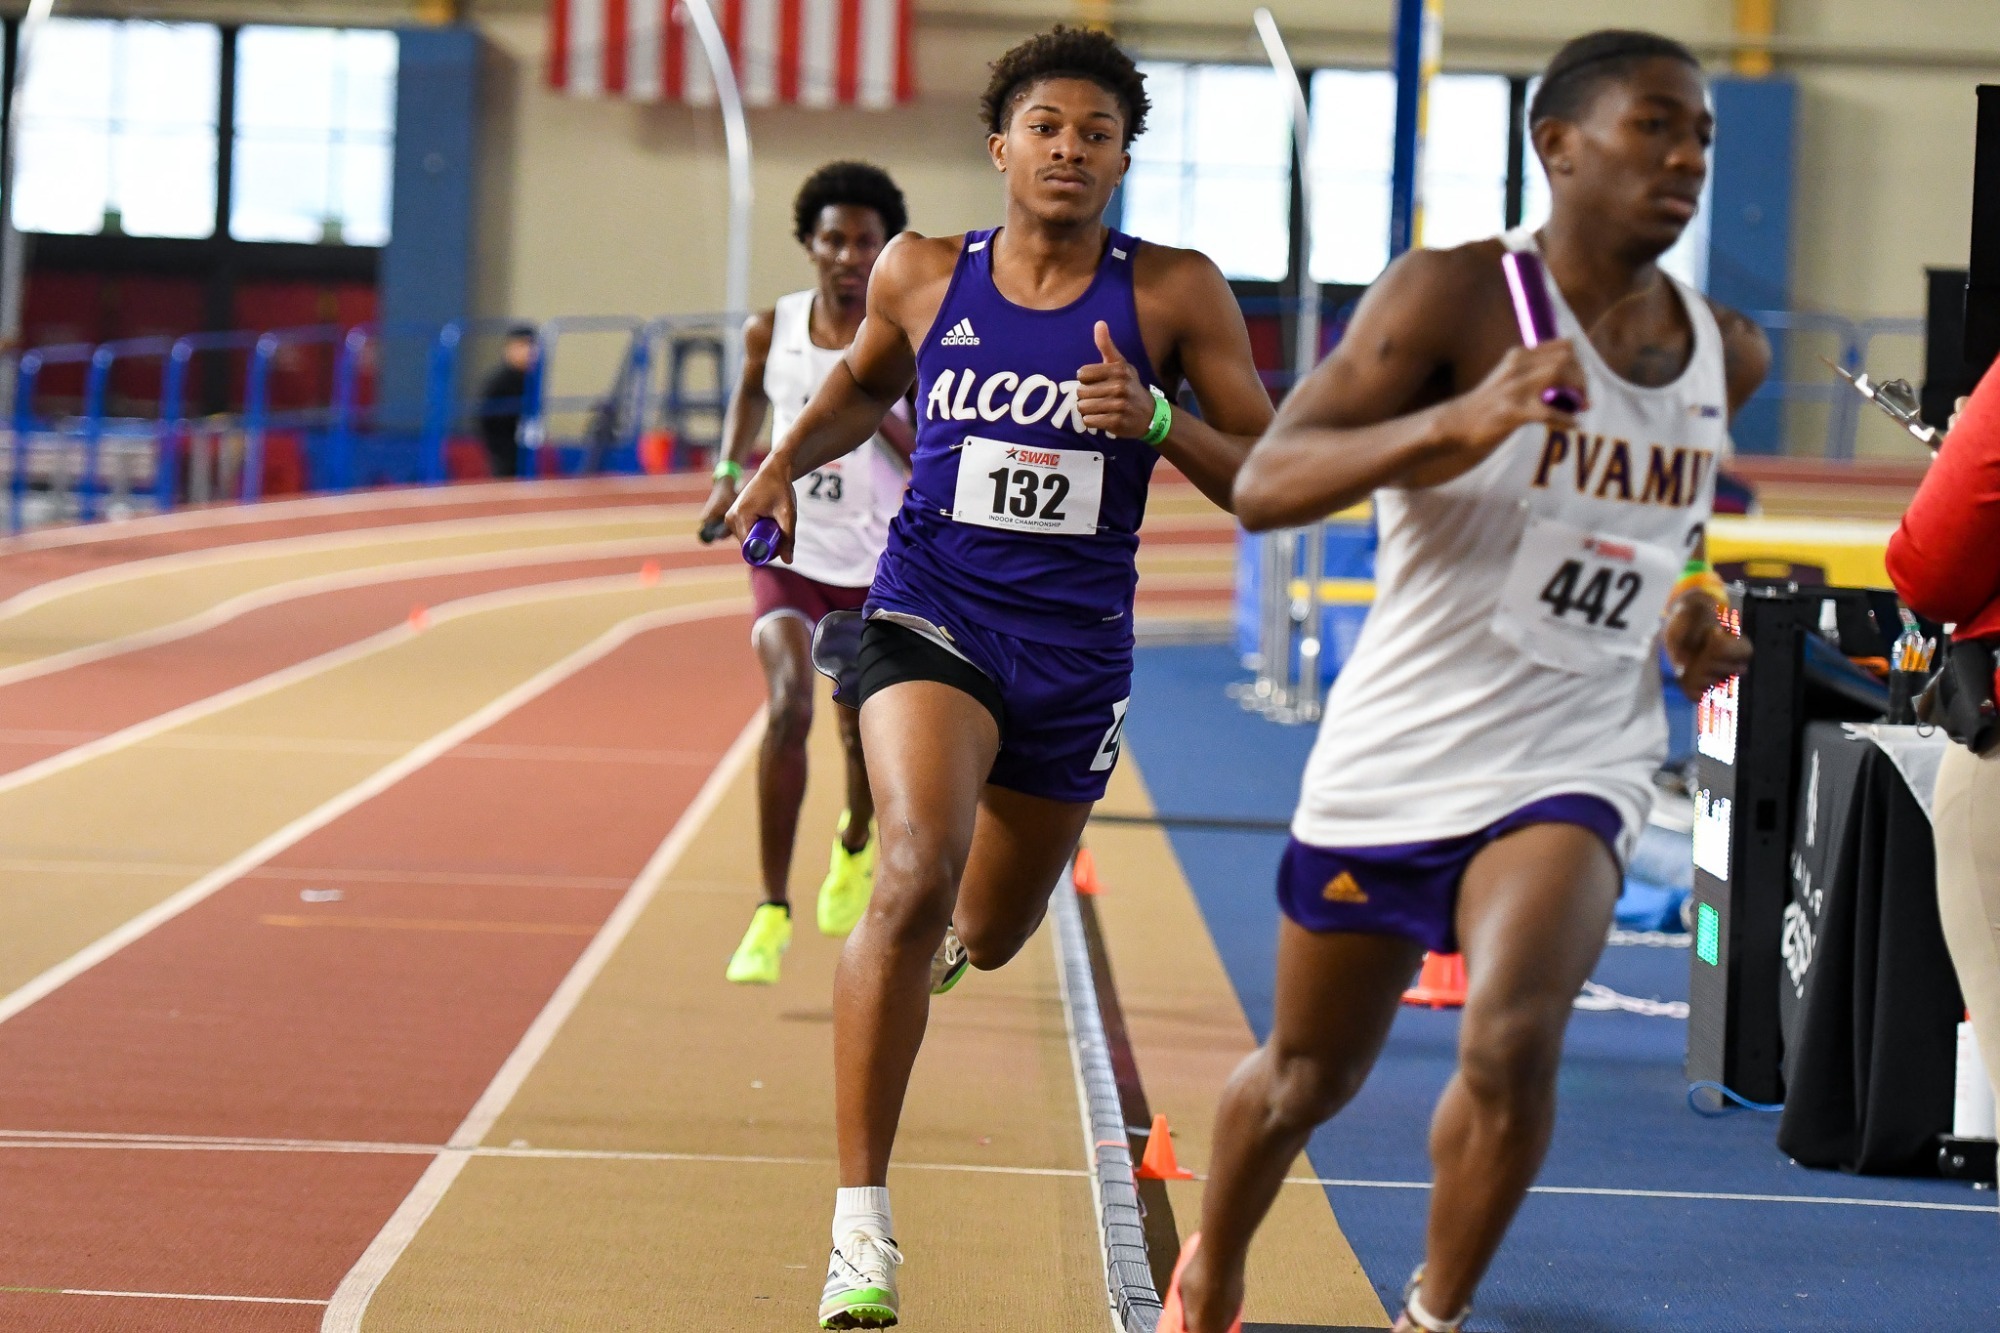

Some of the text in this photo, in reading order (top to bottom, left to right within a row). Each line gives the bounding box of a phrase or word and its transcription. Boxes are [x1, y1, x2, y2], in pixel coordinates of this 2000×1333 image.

[941, 334, 980, 346] adidas
[926, 368, 1117, 439] ALCOR
[1018, 450, 1061, 467] SWAC
[808, 471, 842, 501] 23
[988, 467, 1070, 520] 132
[988, 515, 1013, 523] INDOOR
[1014, 519, 1062, 528] CHAMPIONSHIP
[1538, 558, 1643, 629] 442
